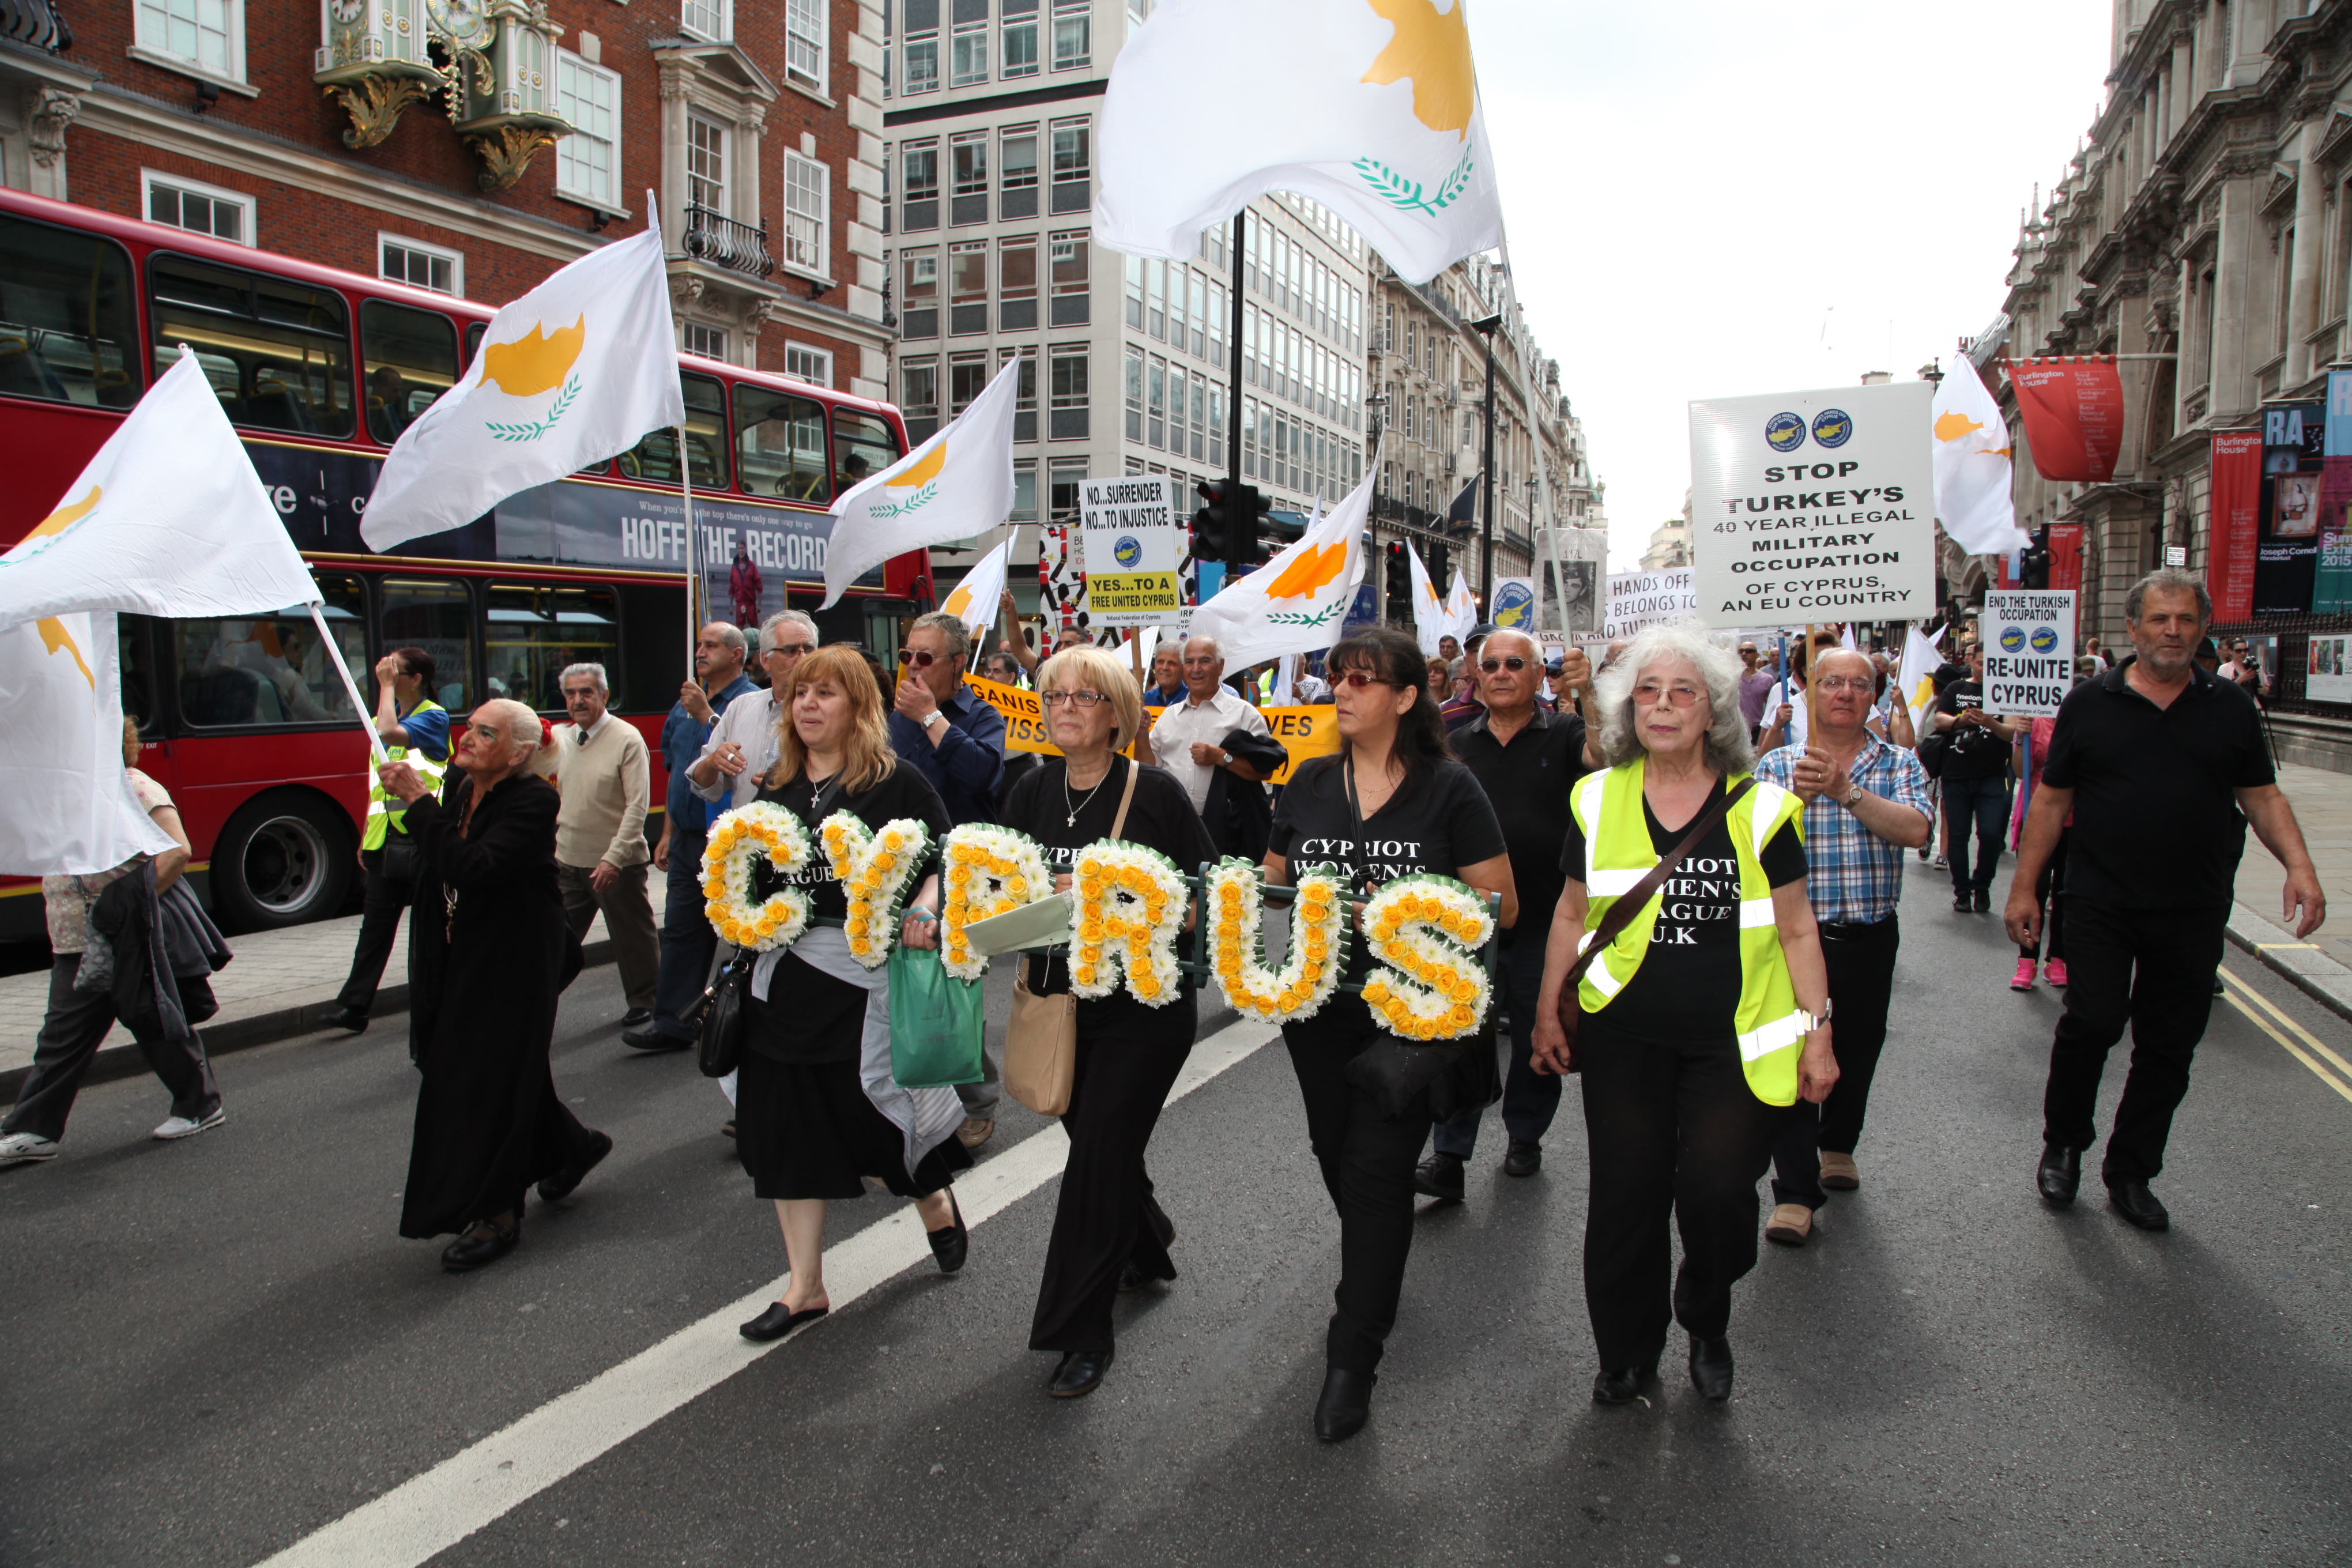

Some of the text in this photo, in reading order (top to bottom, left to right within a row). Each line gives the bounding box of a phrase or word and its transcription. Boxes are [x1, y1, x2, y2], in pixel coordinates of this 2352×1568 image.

[2017, 371, 2064, 380] Burlington
[1768, 414, 1782, 428] CYPRUS
[1778, 417, 1797, 425] SUPPORT
[1821, 414, 1838, 422] CYPRUS
[2266, 410, 2304, 446] RA
[1765, 461, 1859, 483] STOP
[1087, 482, 1162, 506] NO...SURRENDER
[1721, 487, 1904, 514] TURKEY'S
[639, 500, 662, 512] When
[699, 508, 710, 518] the
[713, 510, 725, 521] top
[726, 511, 749, 522] there's
[751, 515, 766, 525] only
[767, 517, 779, 525] one
[781, 519, 794, 528] way
[795, 520, 802, 528] to
[804, 522, 812, 530] go
[1120, 507, 1168, 528] INJUSTICE
[1713, 509, 1914, 533] 40 YEAR ILLEGAL
[621, 517, 828, 572] HOFF THE RECORD
[1752, 533, 1875, 552] MILITARY
[2260, 548, 2288, 556] Joseph
[1731, 552, 1899, 574] OCCUPATION
[2321, 555, 2351, 566] 2015
[1159, 578, 1170, 589] A
[1613, 574, 1690, 596] HANDS OFF
[1746, 576, 1885, 595] OF CYPRUS,
[1091, 594, 1174, 608] FREE UNITED CYPRUS
[1494, 585, 1529, 614] CYPRUS EU MEMBER
[1498, 590, 1525, 610] STILL DIVIDED
[1614, 594, 1675, 617] BELONGS
[1721, 590, 1912, 612] AN EU COUNTRY
[1989, 596, 2070, 608] END THE TURKISH
[1999, 609, 2057, 621] OCCUPATION
[1987, 658, 2069, 680] RE-UNITE
[1991, 684, 2062, 707] CYPRUS
[696, 800, 1497, 1042] CYPRUS
[1650, 926, 1698, 944] U.K
